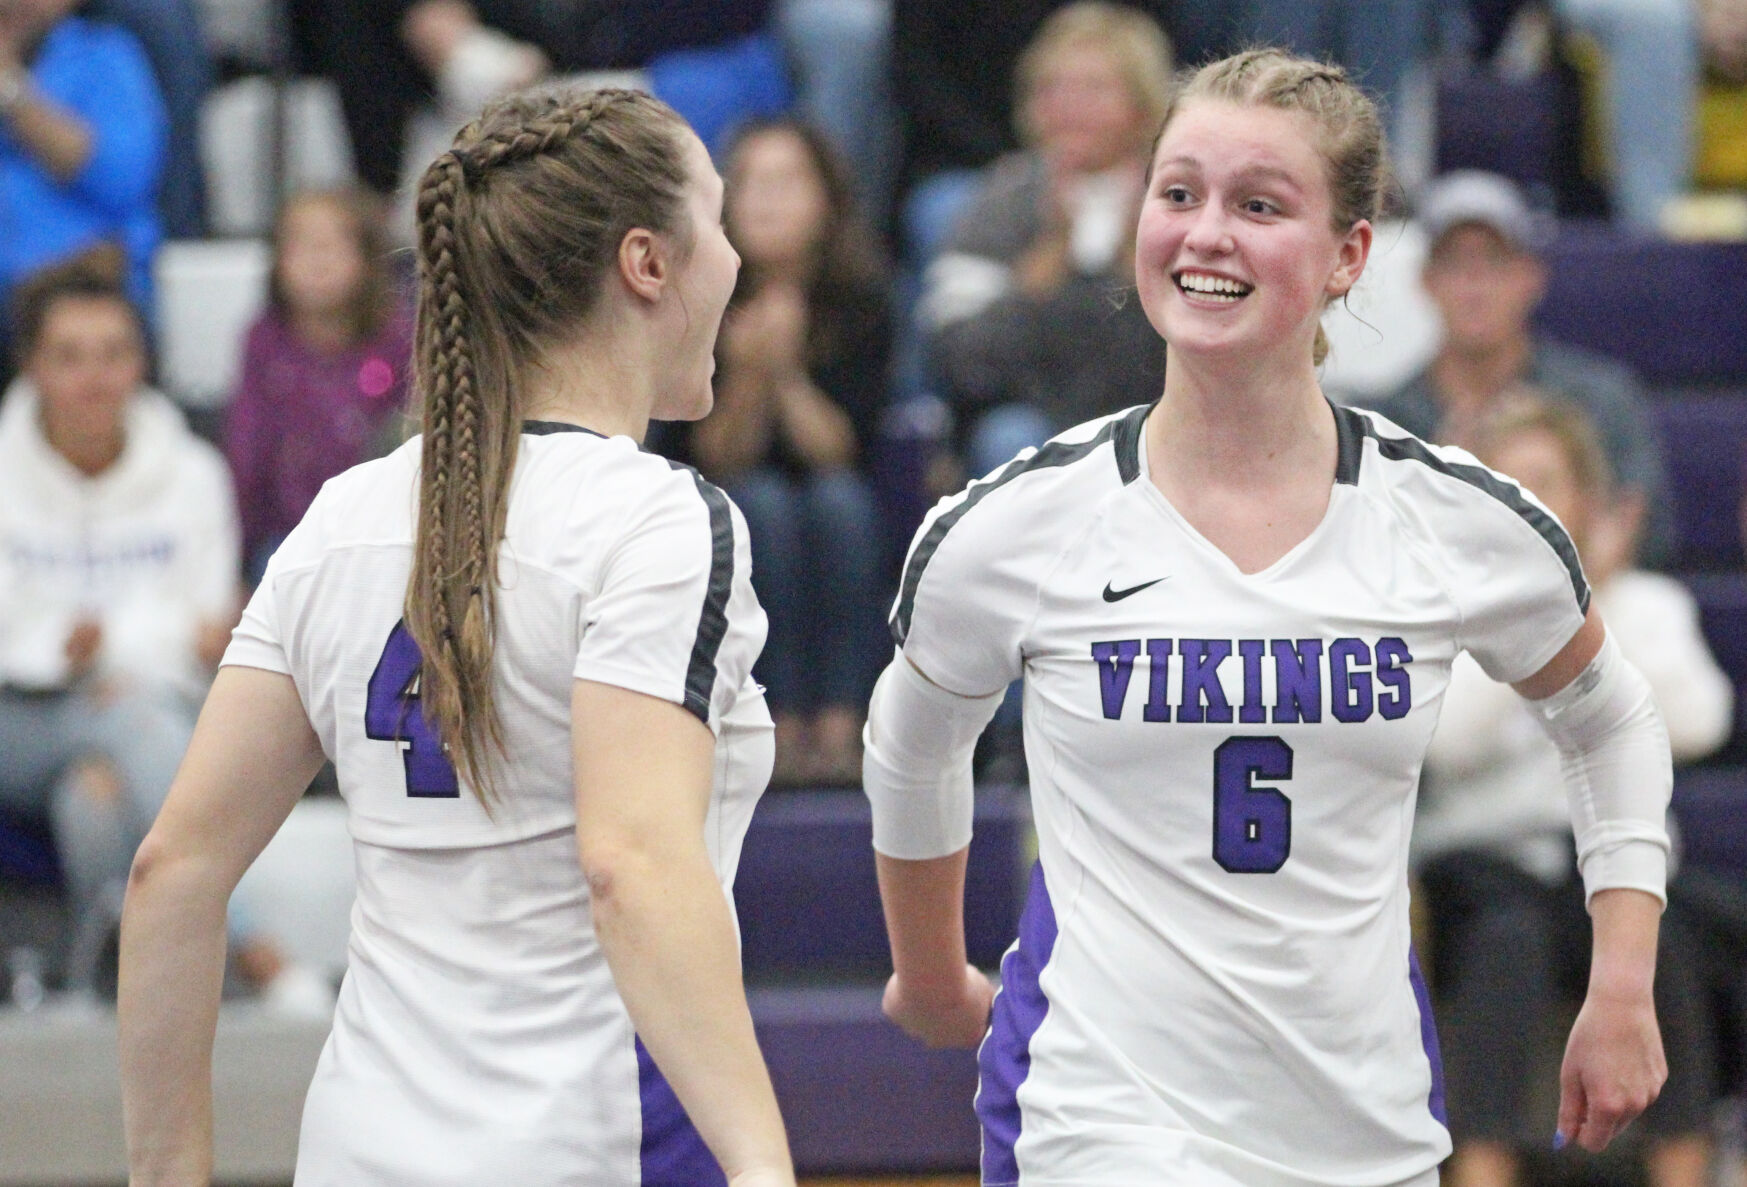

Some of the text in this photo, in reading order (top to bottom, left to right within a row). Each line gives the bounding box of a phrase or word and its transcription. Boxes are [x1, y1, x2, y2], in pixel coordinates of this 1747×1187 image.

[364, 617, 461, 798] 4
[1091, 637, 1414, 724] VIKINGS
[1212, 735, 1294, 874] 6
